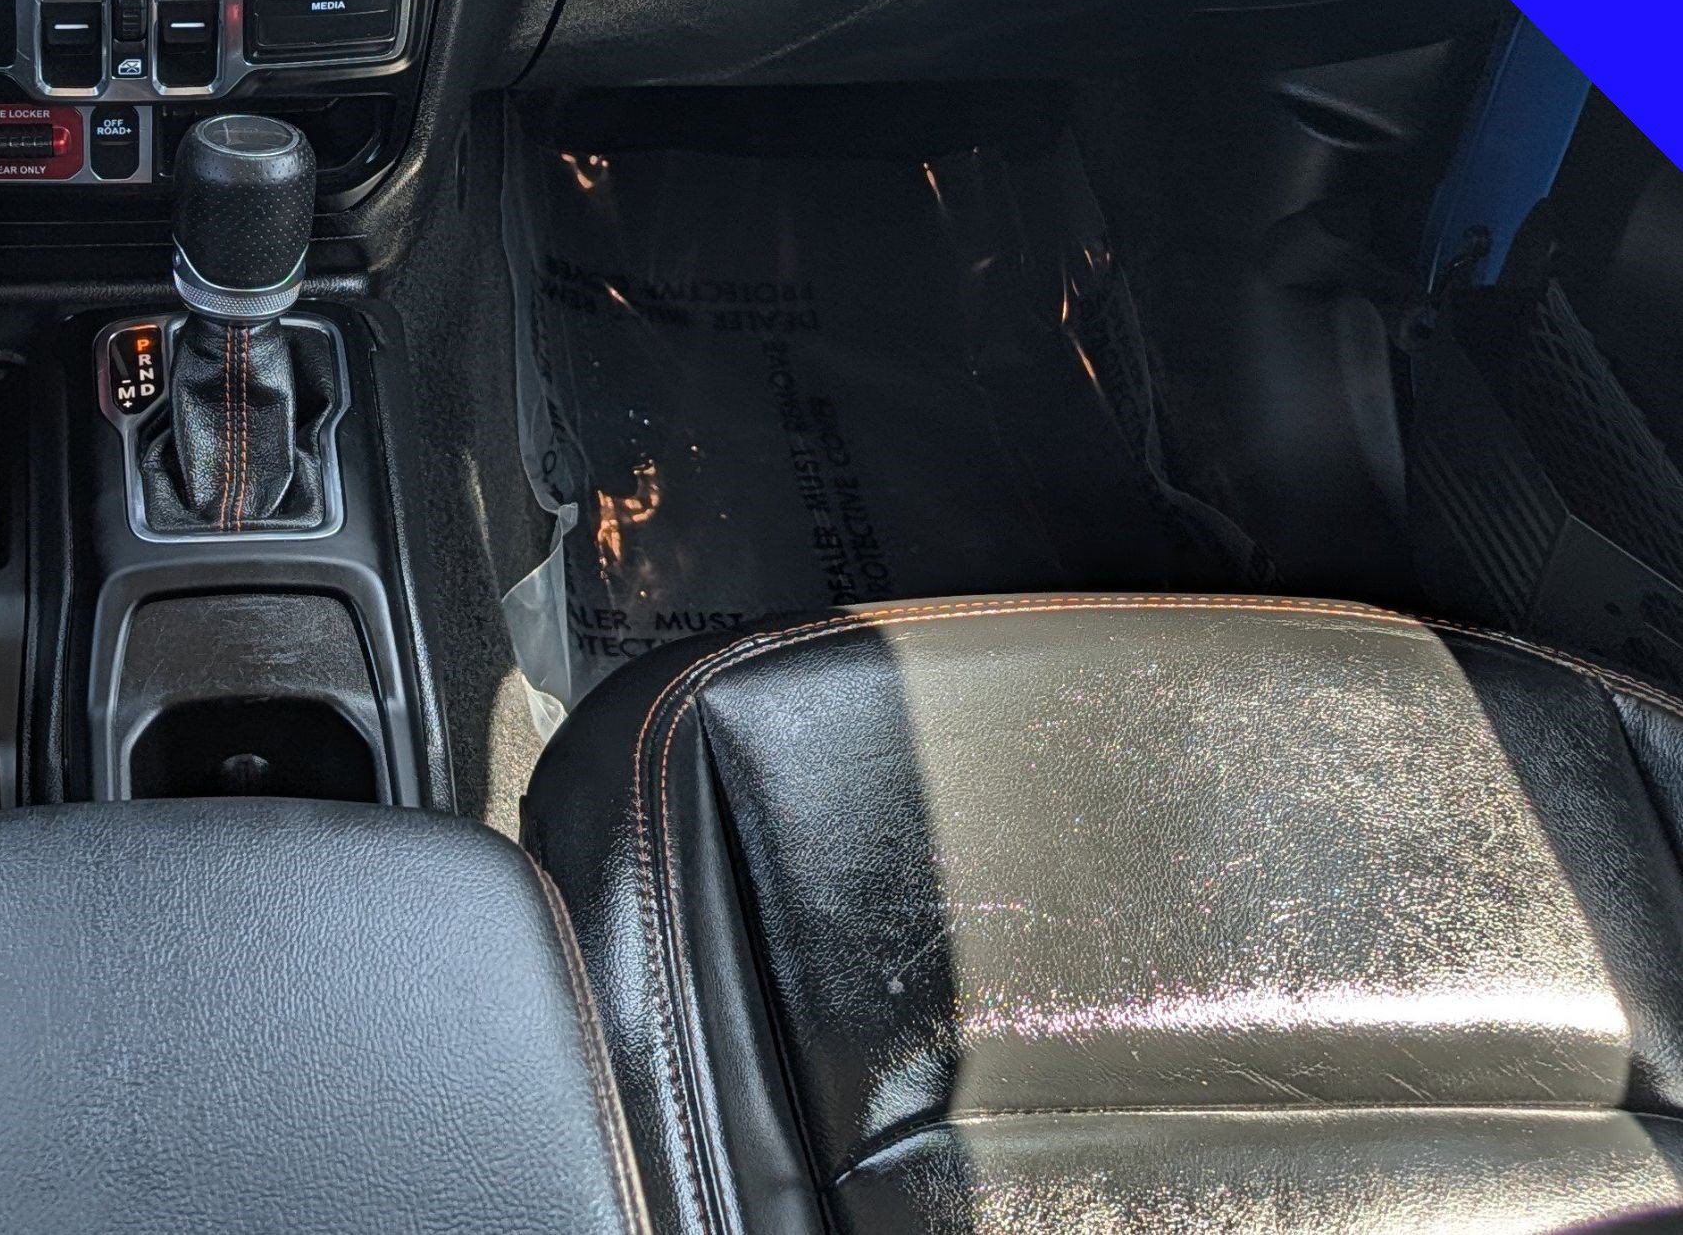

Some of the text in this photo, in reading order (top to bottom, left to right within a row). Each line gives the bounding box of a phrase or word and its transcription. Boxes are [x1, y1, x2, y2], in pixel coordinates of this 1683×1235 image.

[311, 0, 346, 11] MEDIA
[8, 108, 50, 118] LOCKER
[103, 119, 124, 128] OFF
[19, 165, 47, 175] ONLY
[137, 339, 150, 351] P
[138, 354, 152, 366] R
[140, 368, 154, 380] N
[118, 386, 136, 399] M
[141, 384, 156, 396] D
[655, 610, 743, 632] MUST
